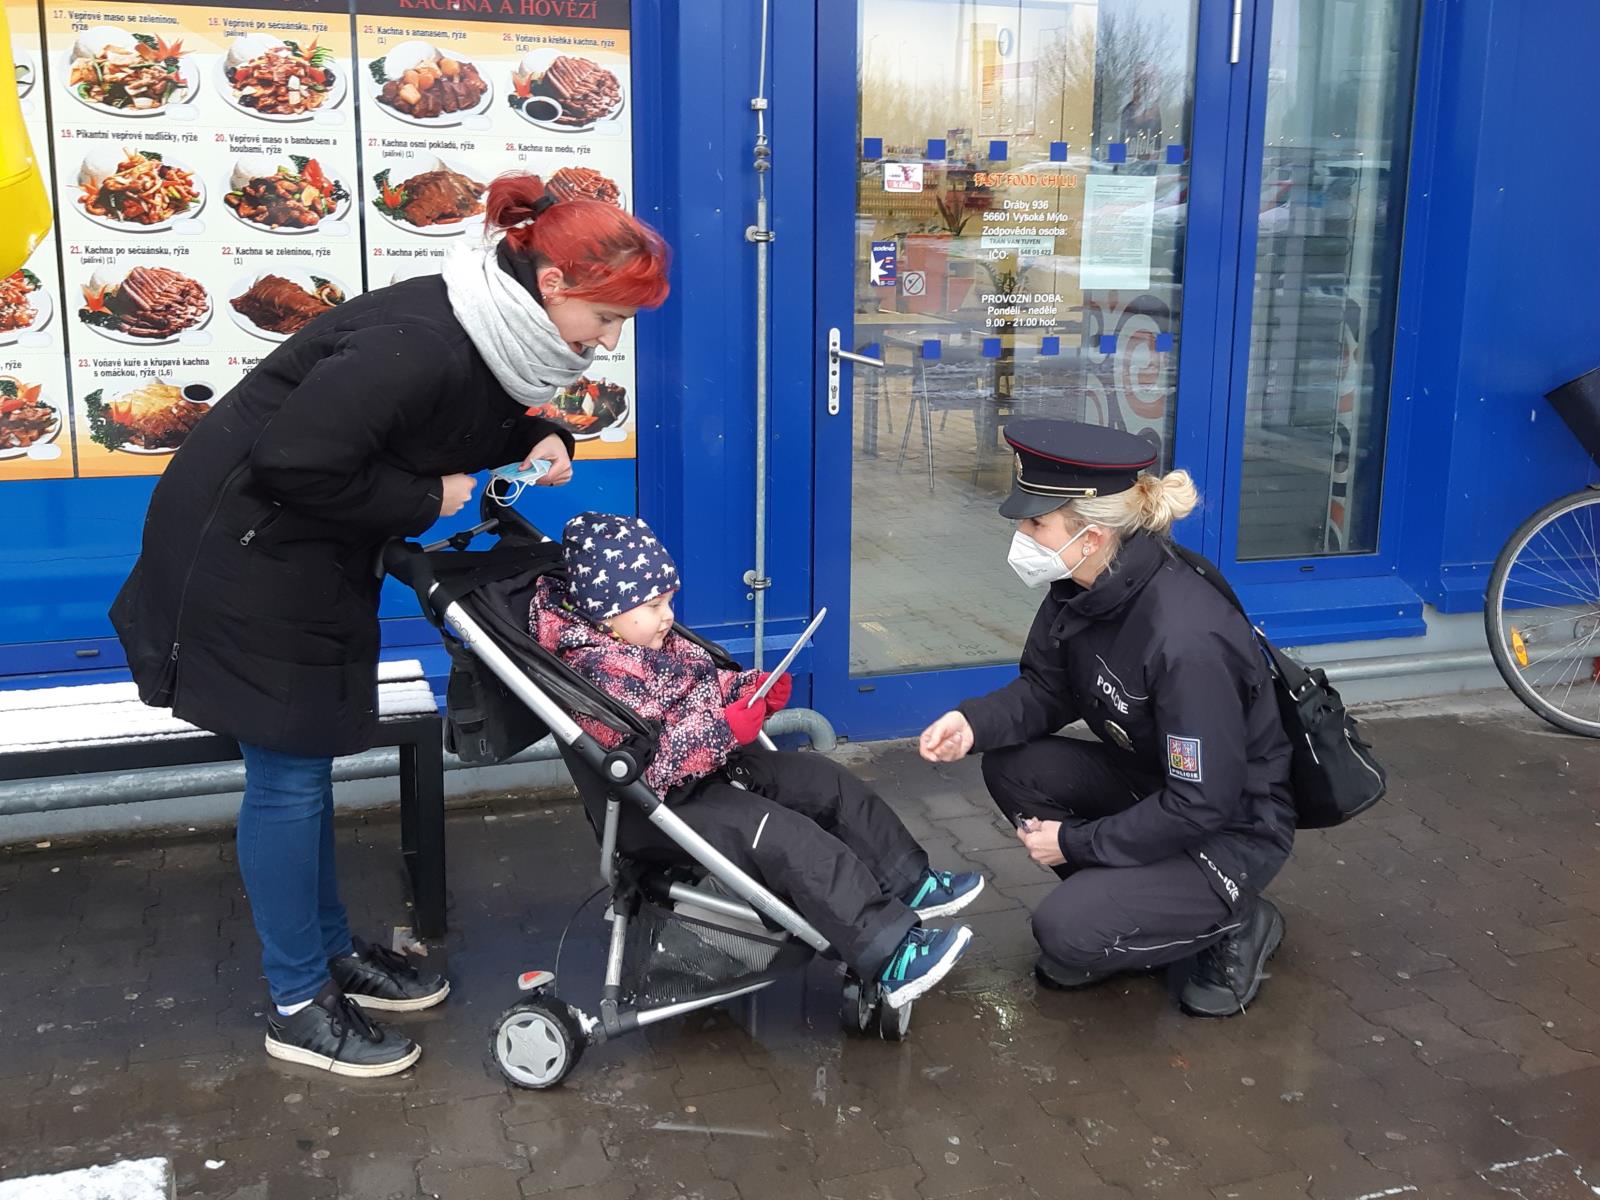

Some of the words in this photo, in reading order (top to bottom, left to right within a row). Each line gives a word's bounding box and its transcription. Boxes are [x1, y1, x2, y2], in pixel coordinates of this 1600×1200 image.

[500, 0, 514, 14] A
[520, 0, 598, 19] HOVĚZÍ
[377, 26, 404, 35] Kachna
[262, 136, 282, 144] maso
[381, 138, 407, 148] Kachna
[518, 143, 543, 152] Kachna
[974, 173, 1003, 187] FAST
[1006, 174, 1038, 187] FOOD
[1003, 200, 1030, 211] Dráby
[1032, 200, 1049, 209] 936
[983, 212, 1010, 222] 56601
[1013, 212, 1045, 223] Vysoké
[1046, 212, 1068, 223] Mýto
[1038, 226, 1068, 236] osoba:
[70, 246, 82, 254] 21.
[84, 245, 114, 255] Kachna
[115, 248, 126, 256] po
[173, 246, 190, 257] rýže
[221, 246, 234, 255] 22.
[235, 246, 263, 255] Kachna
[315, 246, 331, 257] rýže
[373, 247, 384, 256] 29.
[386, 247, 412, 256] Kachna
[107, 256, 116, 265] (1)
[233, 257, 243, 265] (1)
[981, 293, 1032, 304] PROVOZNÍ
[1034, 294, 1064, 303] DOBA:
[1028, 306, 1057, 315] neděle
[985, 319, 1005, 328] 9.00
[1013, 318, 1038, 327] 21.00
[1039, 318, 1058, 326] hod.
[78, 359, 91, 368] 23.
[123, 357, 141, 367] kuře
[182, 357, 210, 366] kachna
[228, 356, 240, 365] 24.
[241, 356, 260, 365] Kach
[100, 367, 138, 377] omáčkou,
[140, 367, 156, 378] rýže
